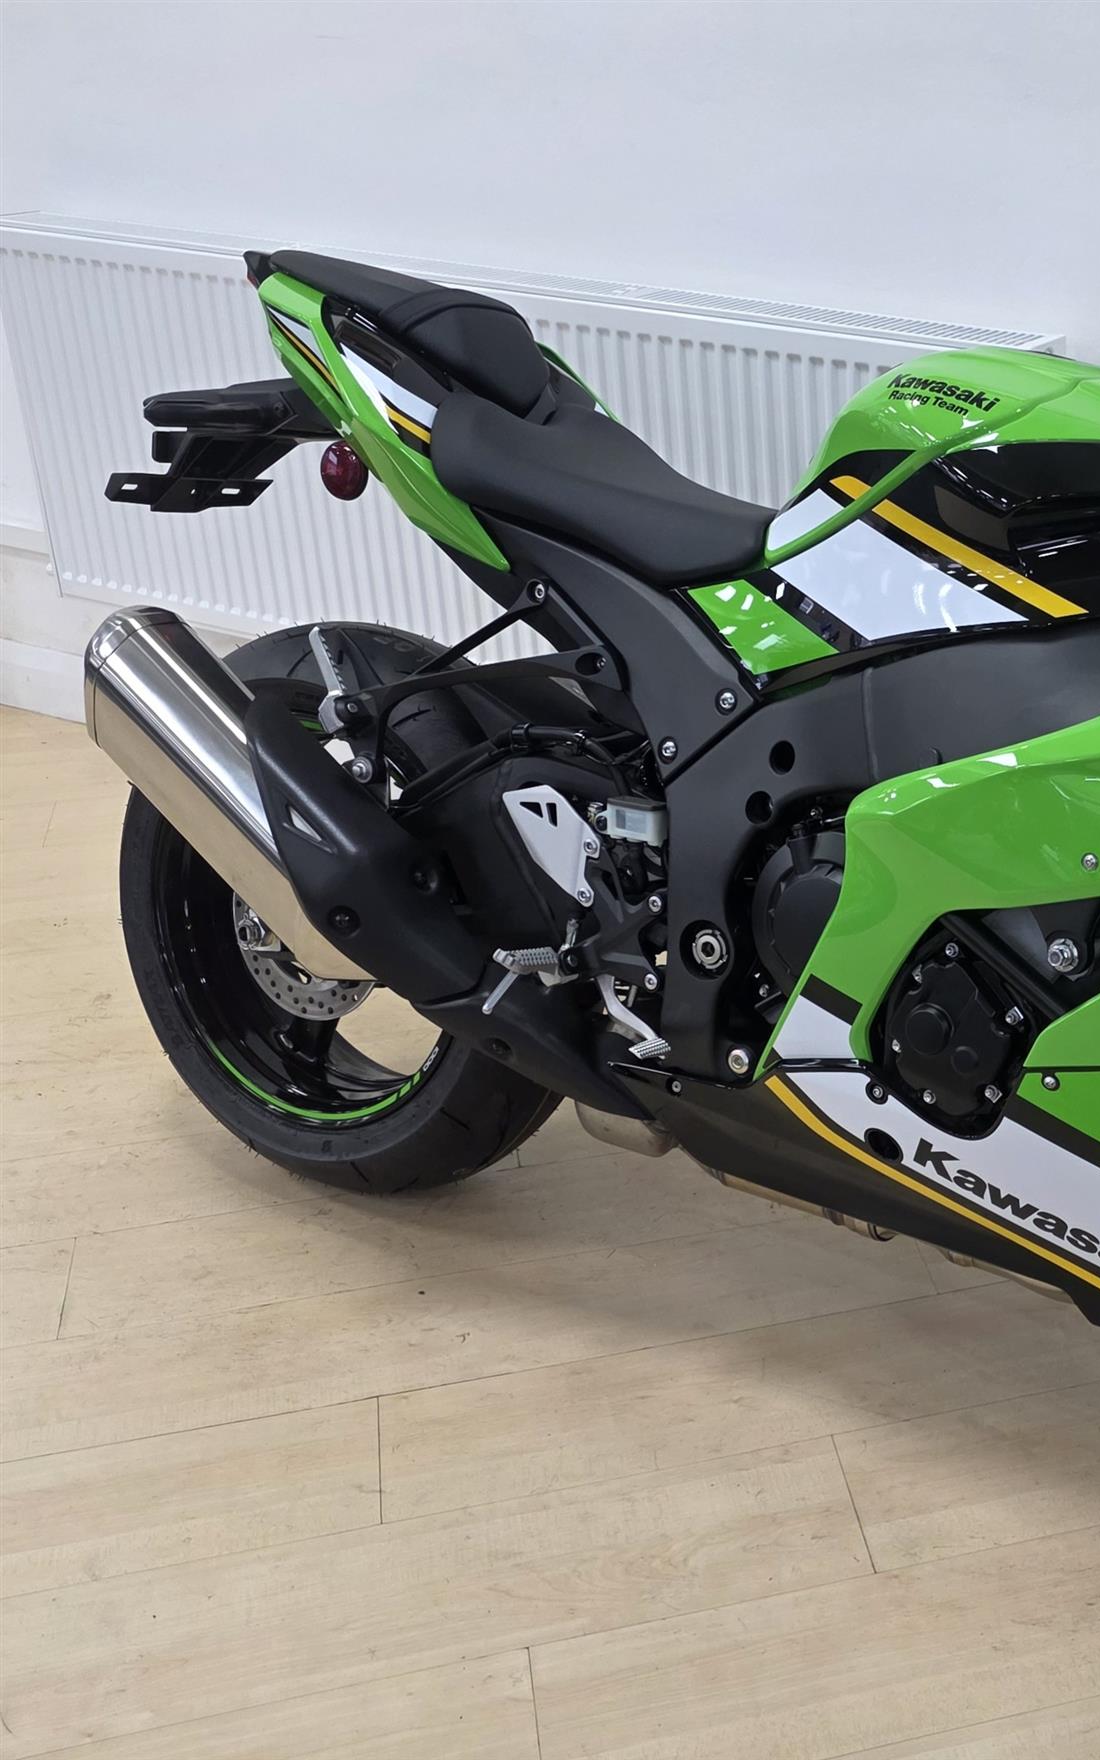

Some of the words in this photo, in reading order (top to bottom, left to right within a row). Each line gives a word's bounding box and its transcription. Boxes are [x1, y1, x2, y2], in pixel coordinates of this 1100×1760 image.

[887, 373, 1001, 412] Kawasaki
[888, 390, 931, 405] Racing
[932, 395, 969, 416] Team
